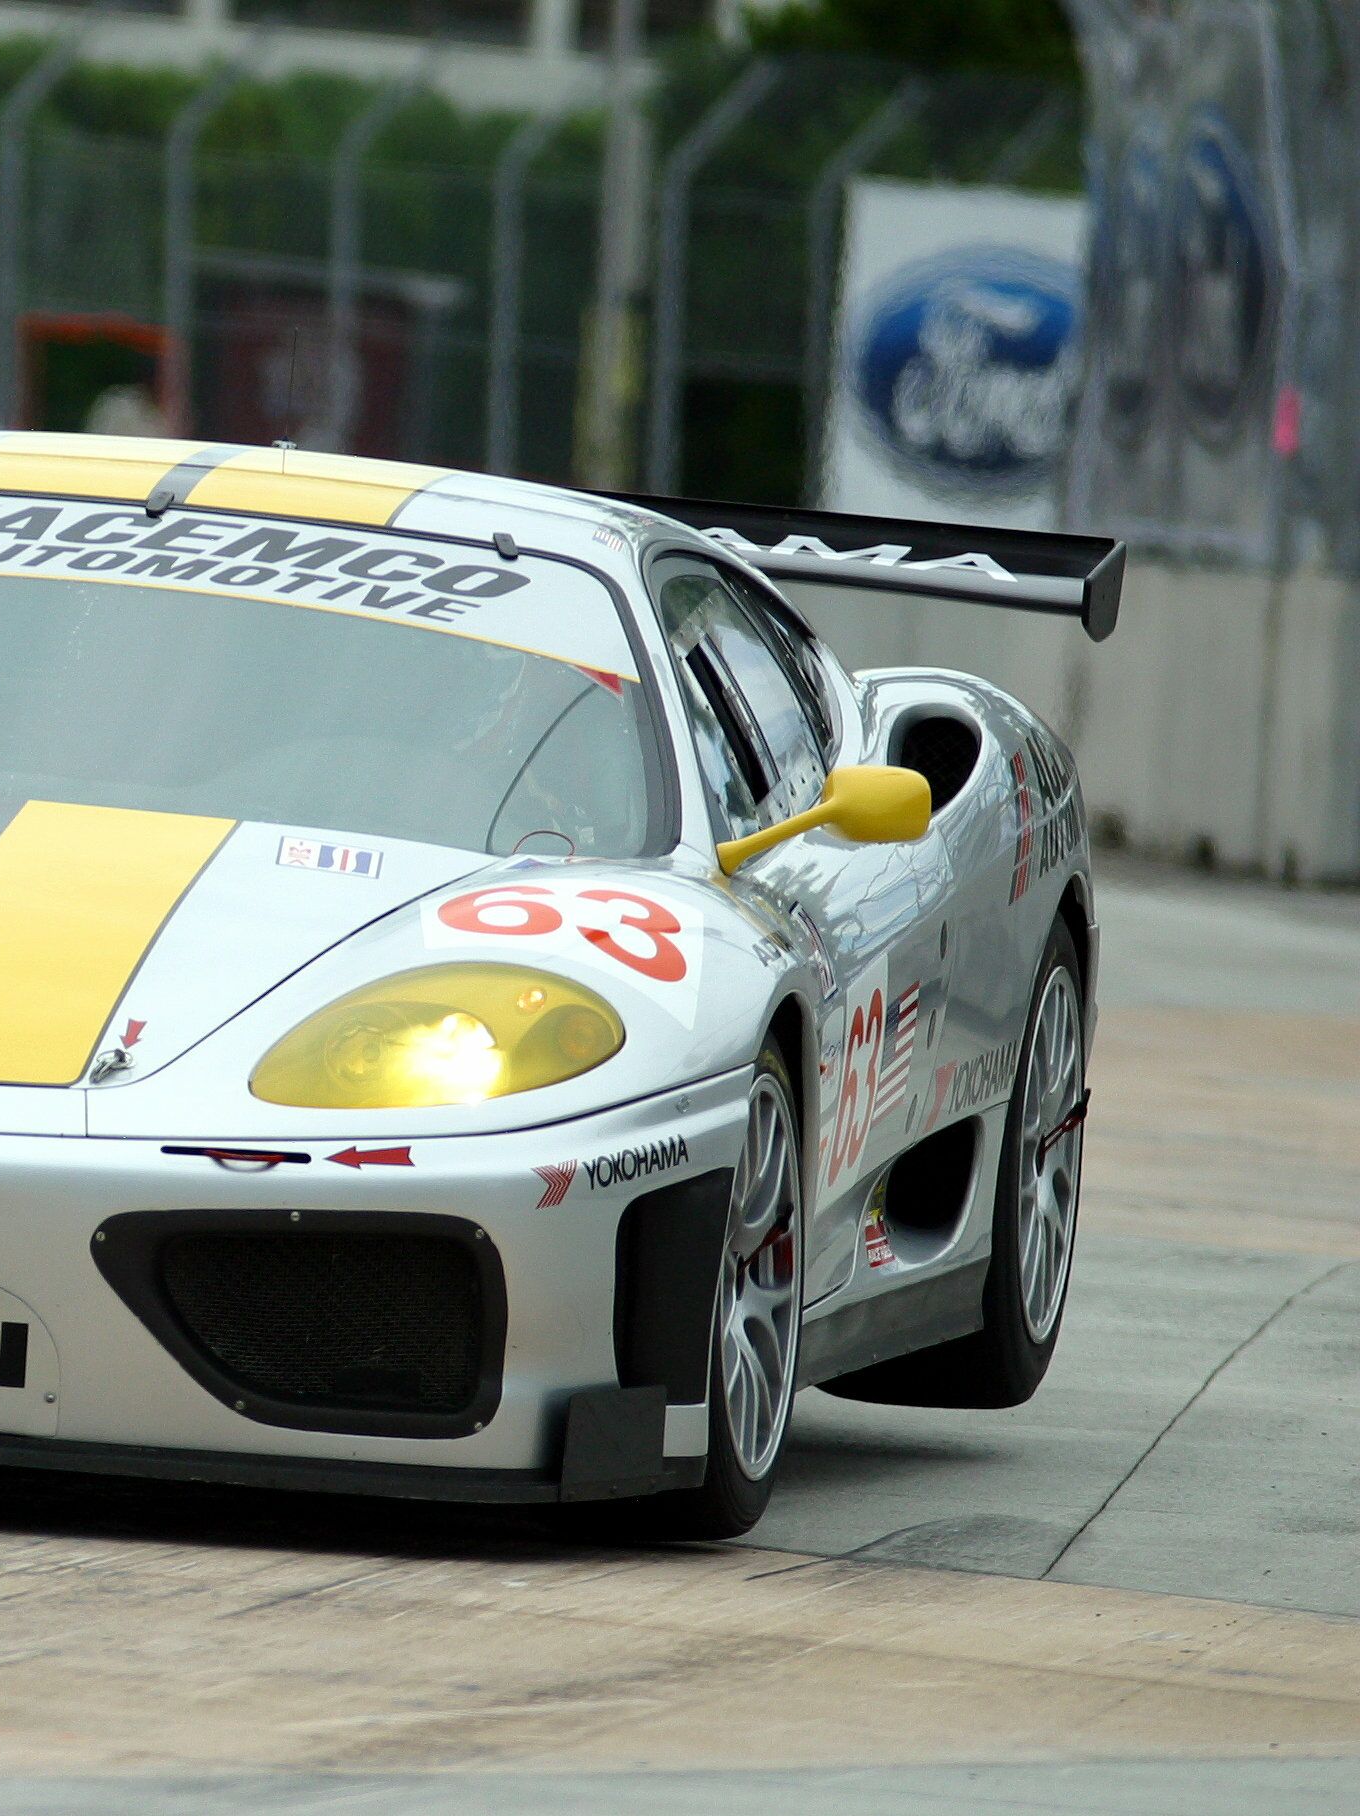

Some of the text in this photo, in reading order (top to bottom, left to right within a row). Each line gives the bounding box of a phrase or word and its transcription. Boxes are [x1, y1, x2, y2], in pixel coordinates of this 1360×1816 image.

[437, 886, 687, 982] 63
[829, 987, 883, 1187] 63
[584, 1134, 689, 1190] YOKOHAMA
